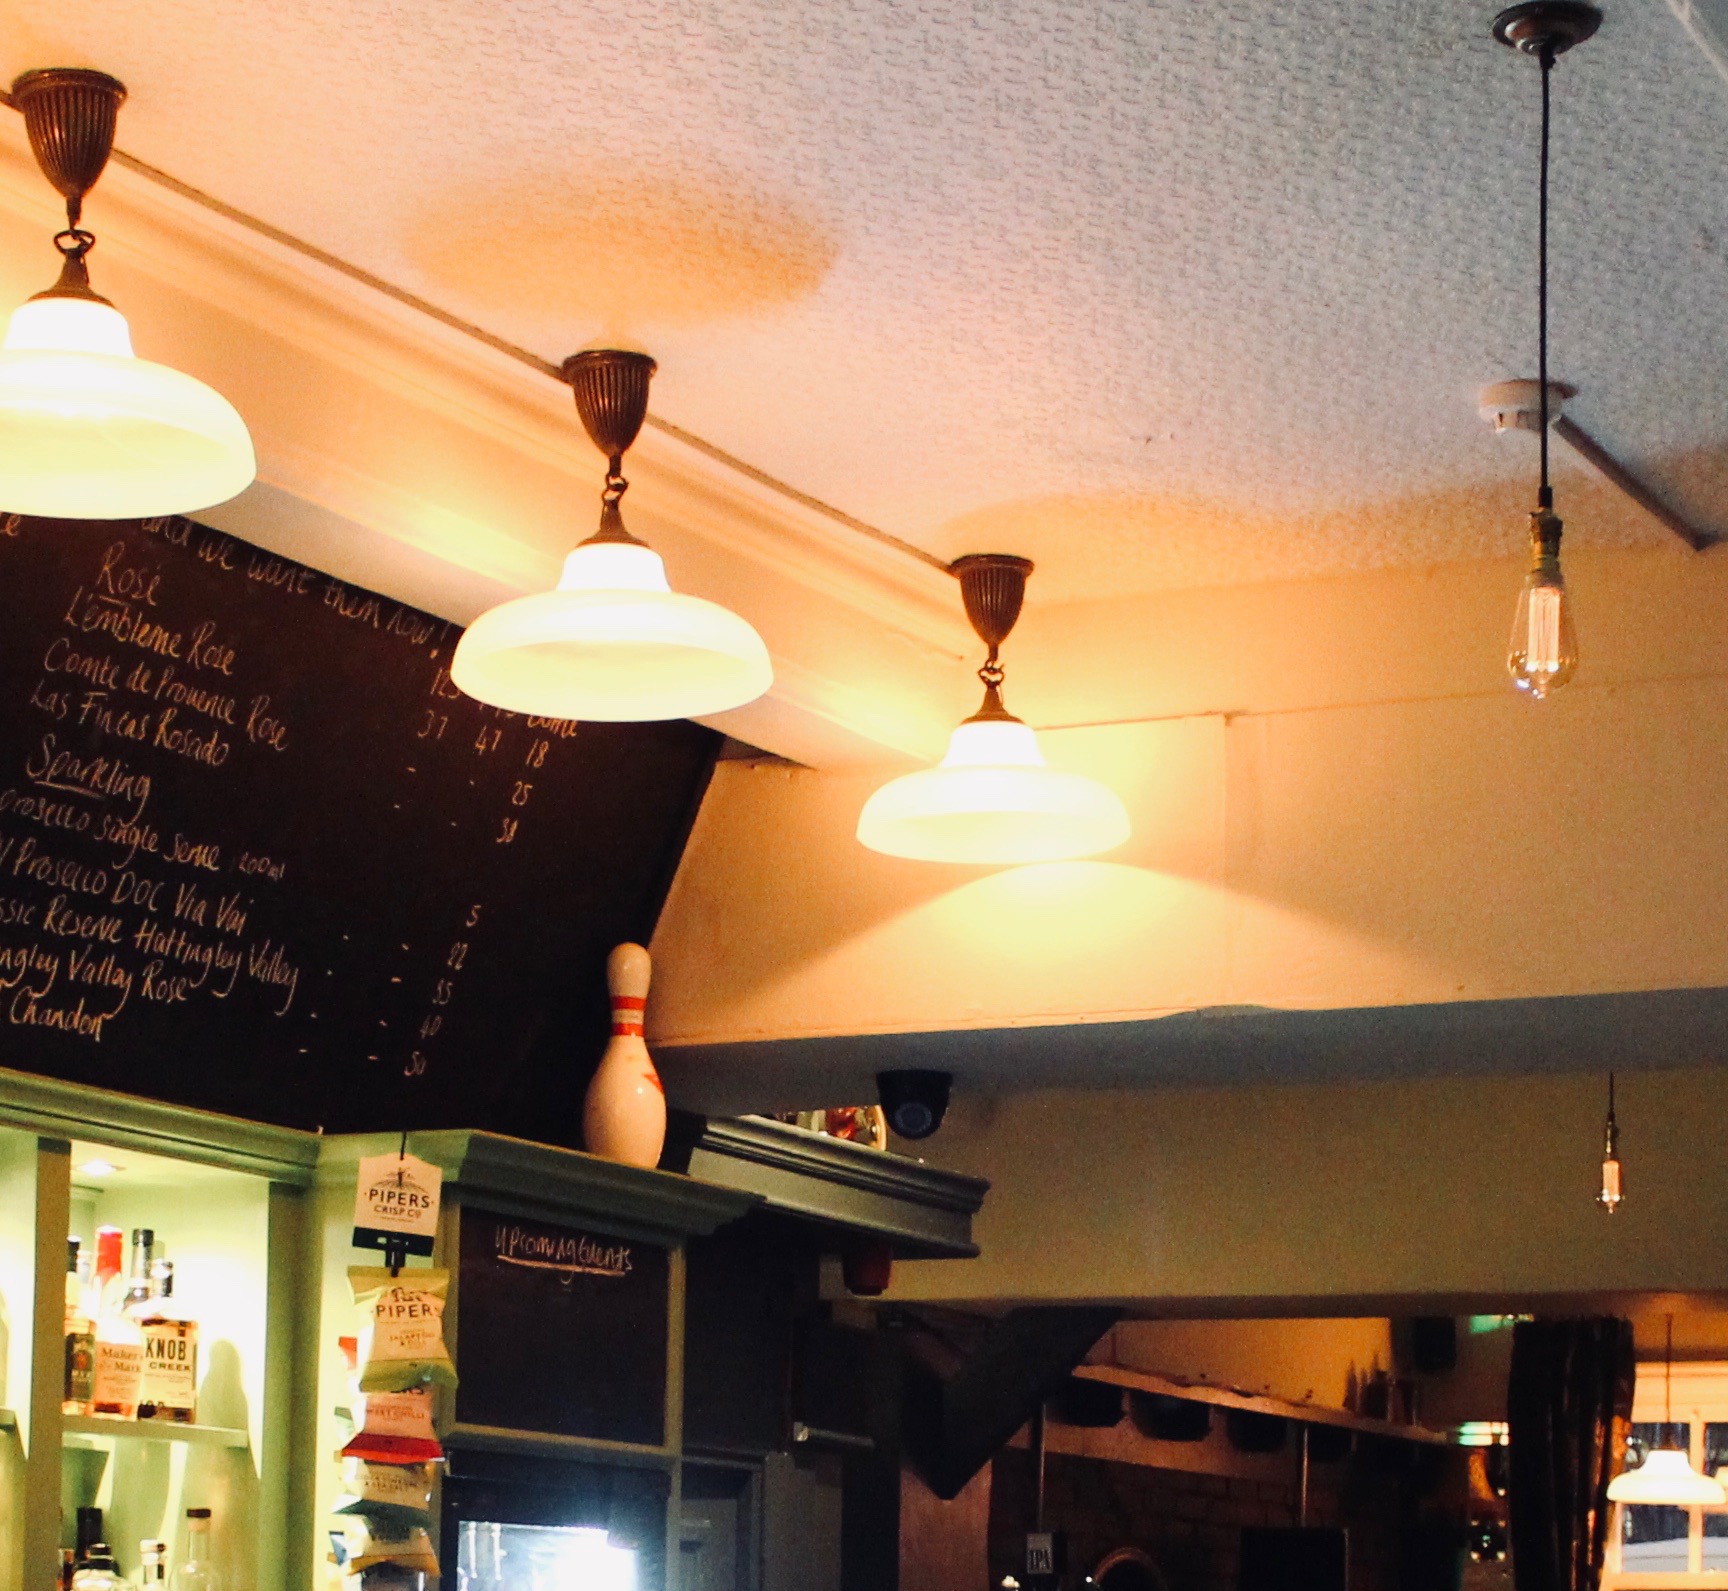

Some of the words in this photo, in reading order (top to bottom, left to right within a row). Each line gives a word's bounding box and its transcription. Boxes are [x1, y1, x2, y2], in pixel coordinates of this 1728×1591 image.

[126, 660, 152, 694] de
[369, 1188, 430, 1209] PIPERS
[374, 1203, 405, 1216] CRISP
[146, 1337, 186, 1361] KNOB
[149, 1361, 192, 1372] CREEK
[1029, 1548, 1052, 1573] IPA
